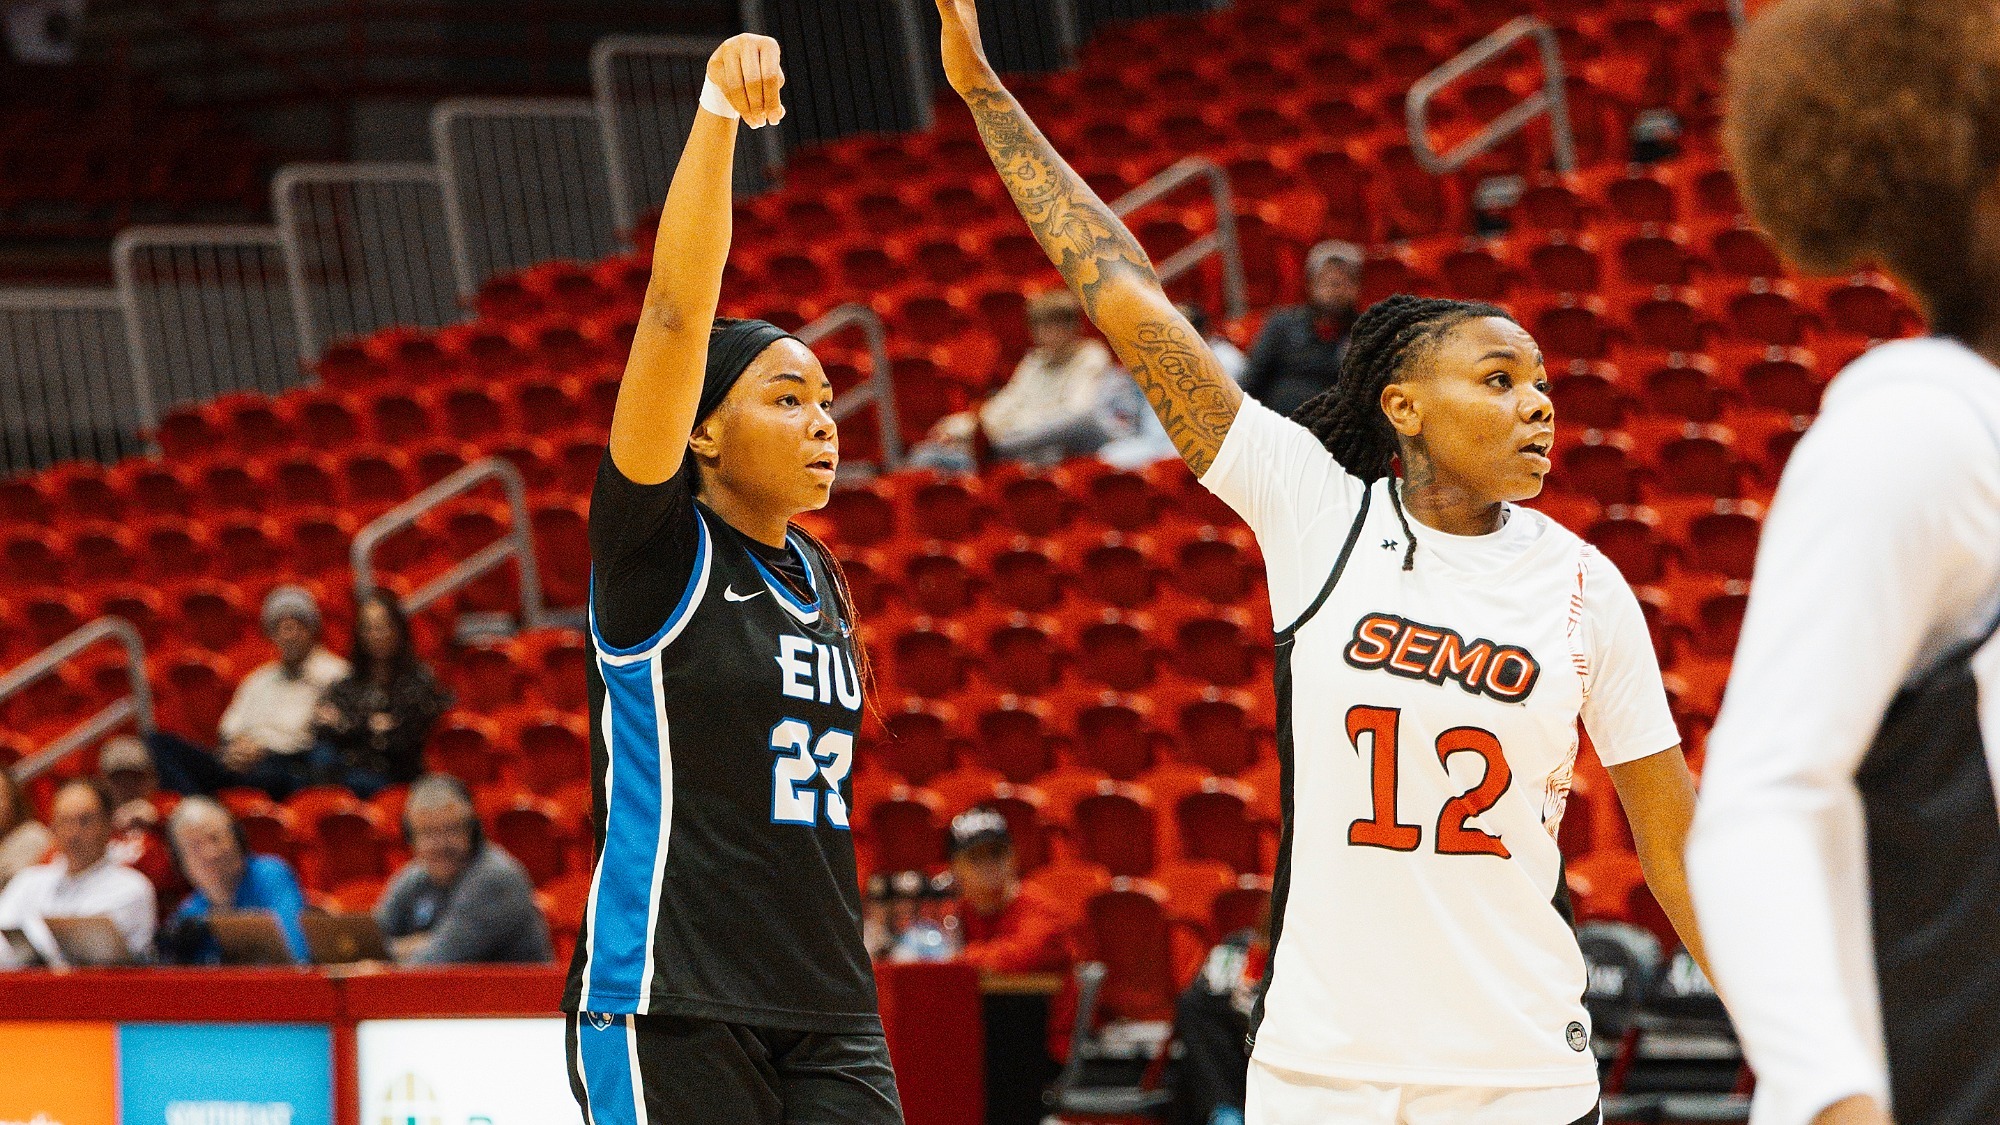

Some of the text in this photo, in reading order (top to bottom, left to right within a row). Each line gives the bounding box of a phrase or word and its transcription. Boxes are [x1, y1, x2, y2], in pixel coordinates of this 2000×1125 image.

[775, 634, 861, 711] EIU
[1345, 613, 1540, 702] SEMO
[769, 716, 854, 829] 23
[1345, 704, 1512, 859] 12
